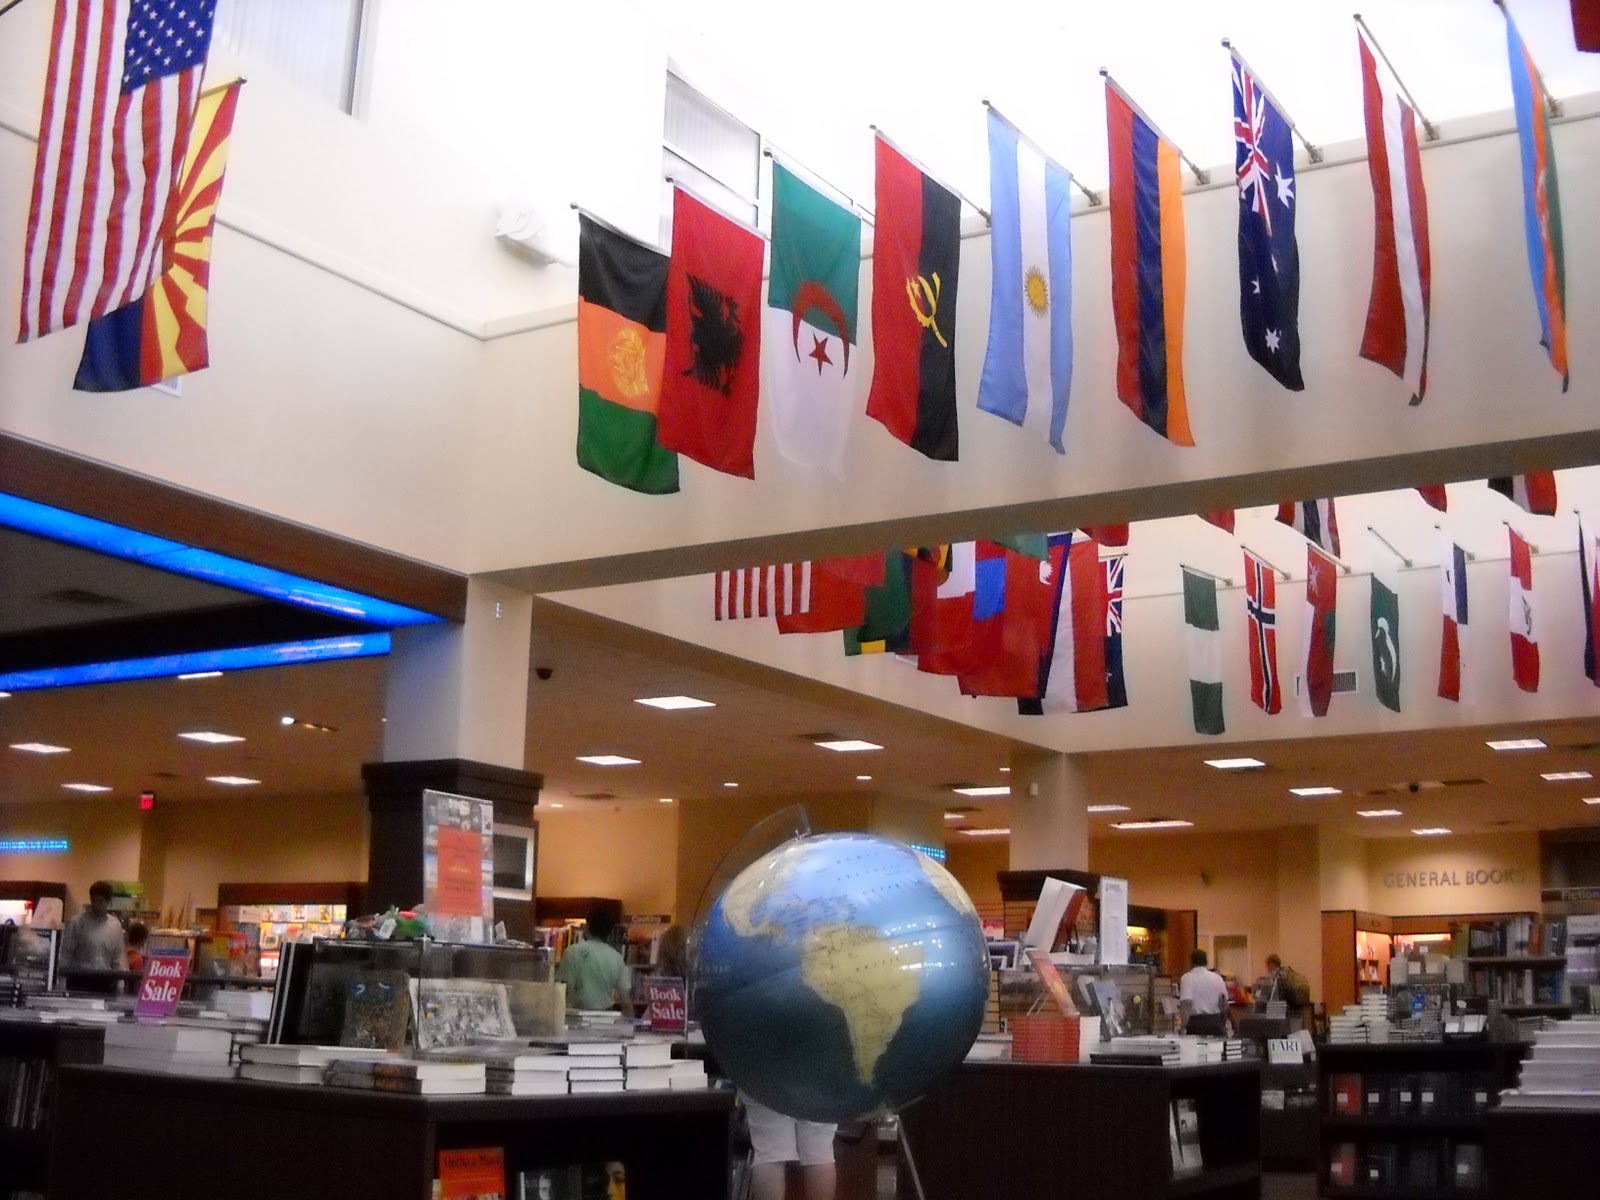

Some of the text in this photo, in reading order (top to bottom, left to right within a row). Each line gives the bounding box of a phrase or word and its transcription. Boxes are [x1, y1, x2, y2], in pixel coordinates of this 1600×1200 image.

[1384, 870, 1461, 888] GENERAL
[631, 914, 661, 924] Cooking
[150, 960, 182, 978] Book
[141, 980, 177, 1002] Sale
[650, 987, 681, 1001] Book
[652, 1002, 685, 1020] Sale
